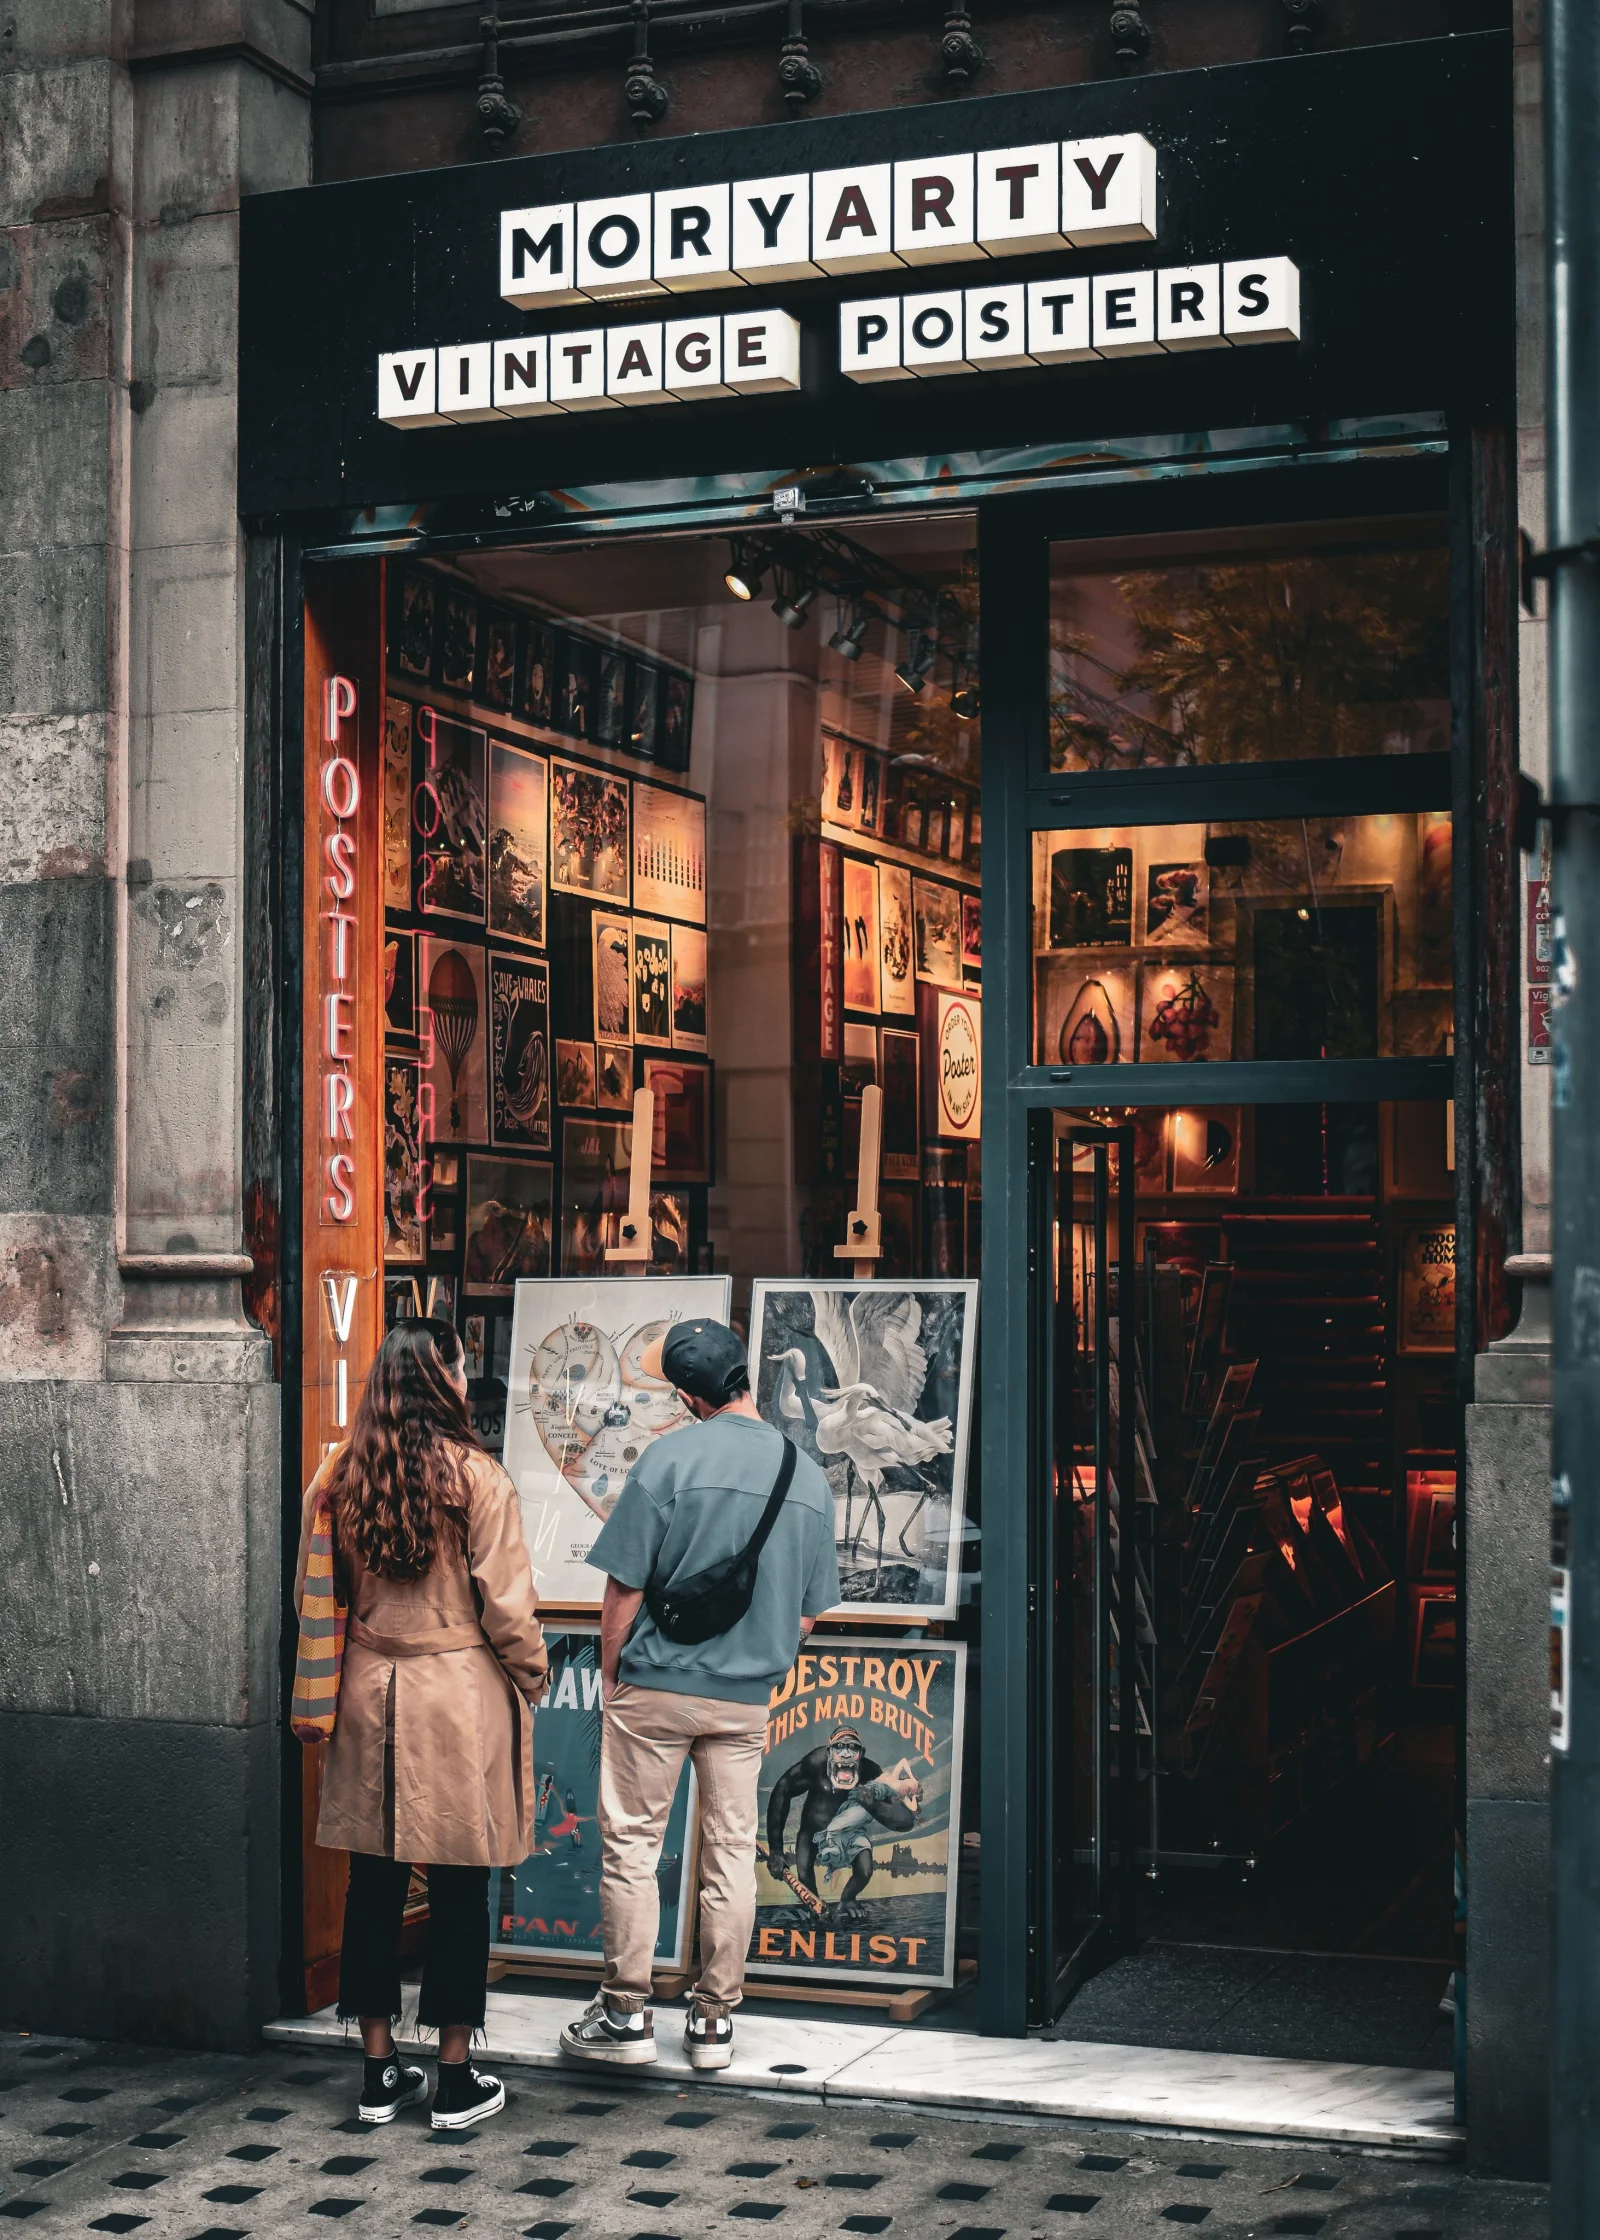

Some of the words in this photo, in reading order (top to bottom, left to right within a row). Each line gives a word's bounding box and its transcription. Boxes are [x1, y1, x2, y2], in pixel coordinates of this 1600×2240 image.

[511, 152, 1124, 281] MORYARTY
[392, 325, 768, 402] VINTAGE
[857, 272, 1271, 356] POSTERS
[321, 675, 360, 1221] POSTERS
[823, 853, 833, 1051] VINTAGE
[493, 971, 513, 996] SAVE
[517, 975, 546, 1004] WHALES
[945, 1014, 960, 1041] ORDER
[961, 1018, 973, 1045] YOUR
[943, 1048, 975, 1085] Poster
[1421, 1254, 1455, 1264] HOM
[1425, 1244, 1455, 1254] COM
[470, 1412, 504, 1437] POS
[589, 1458, 608, 1471] LOVE
[571, 1550, 590, 1558] WO
[764, 1702, 808, 1756] THIS
[815, 1694, 865, 1722] MAD
[869, 1700, 936, 1767] BRUTE
[502, 1915, 580, 1936] PAN
[758, 1927, 927, 1966] ENLIST
